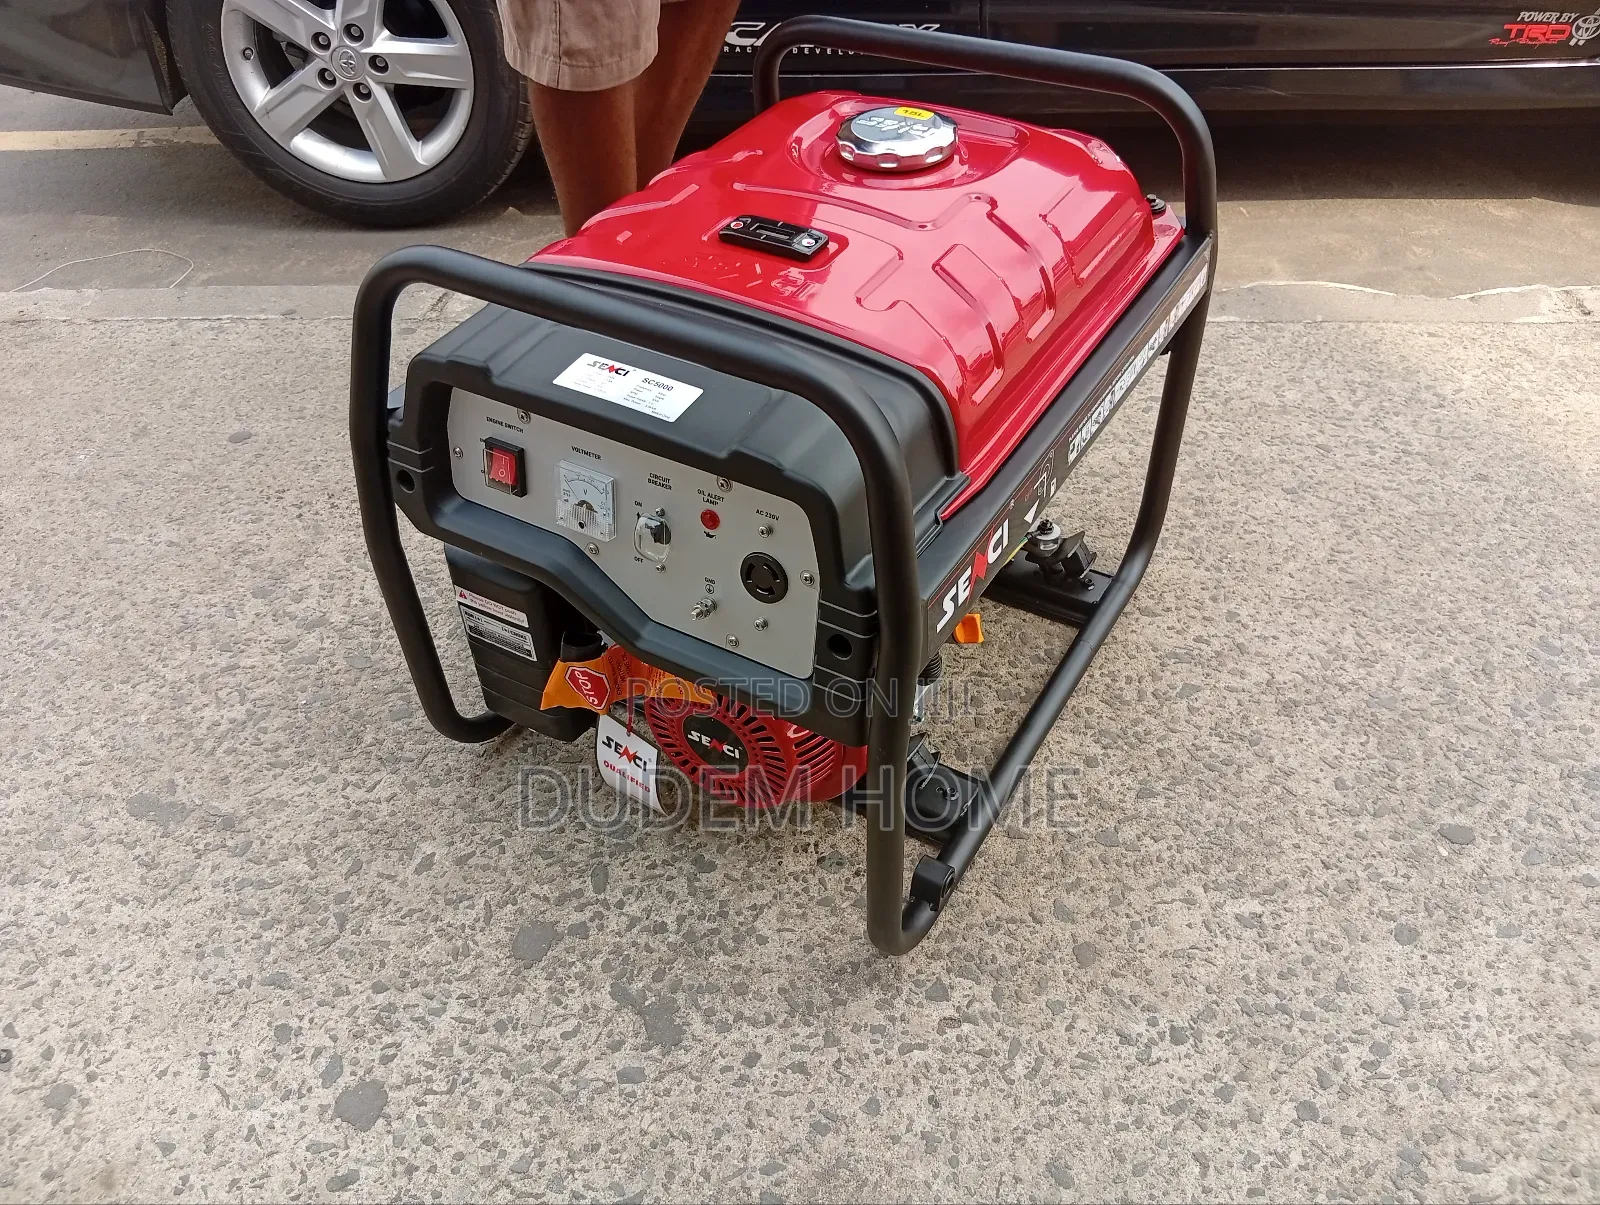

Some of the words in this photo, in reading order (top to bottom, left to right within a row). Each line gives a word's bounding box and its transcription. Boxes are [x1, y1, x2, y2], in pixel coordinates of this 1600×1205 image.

[1517, 11, 1560, 24] POWER
[1558, 12, 1579, 23] BY
[1503, 24, 1572, 42] TRD
[587, 360, 630, 377] SENCI
[642, 377, 674, 391] SC5000
[486, 416, 504, 427] ENGINE
[504, 422, 524, 433] SWITCH
[571, 445, 602, 460] VOLTMETER
[647, 477, 672, 490] BREAKER
[649, 472, 671, 484] CIRCUIT
[697, 488, 706, 497] OIL
[707, 492, 724, 502] ALERT
[702, 497, 719, 506] LAMP
[755, 509, 764, 517] AC
[765, 511, 780, 522] 230V
[704, 577, 716, 585] GND
[936, 518, 1009, 633] SENCI
[574, 670, 599, 704] STOP
[687, 730, 740, 759] SENCI
[602, 735, 648, 772] SENCI
[603, 759, 651, 793] QUALIFIED
